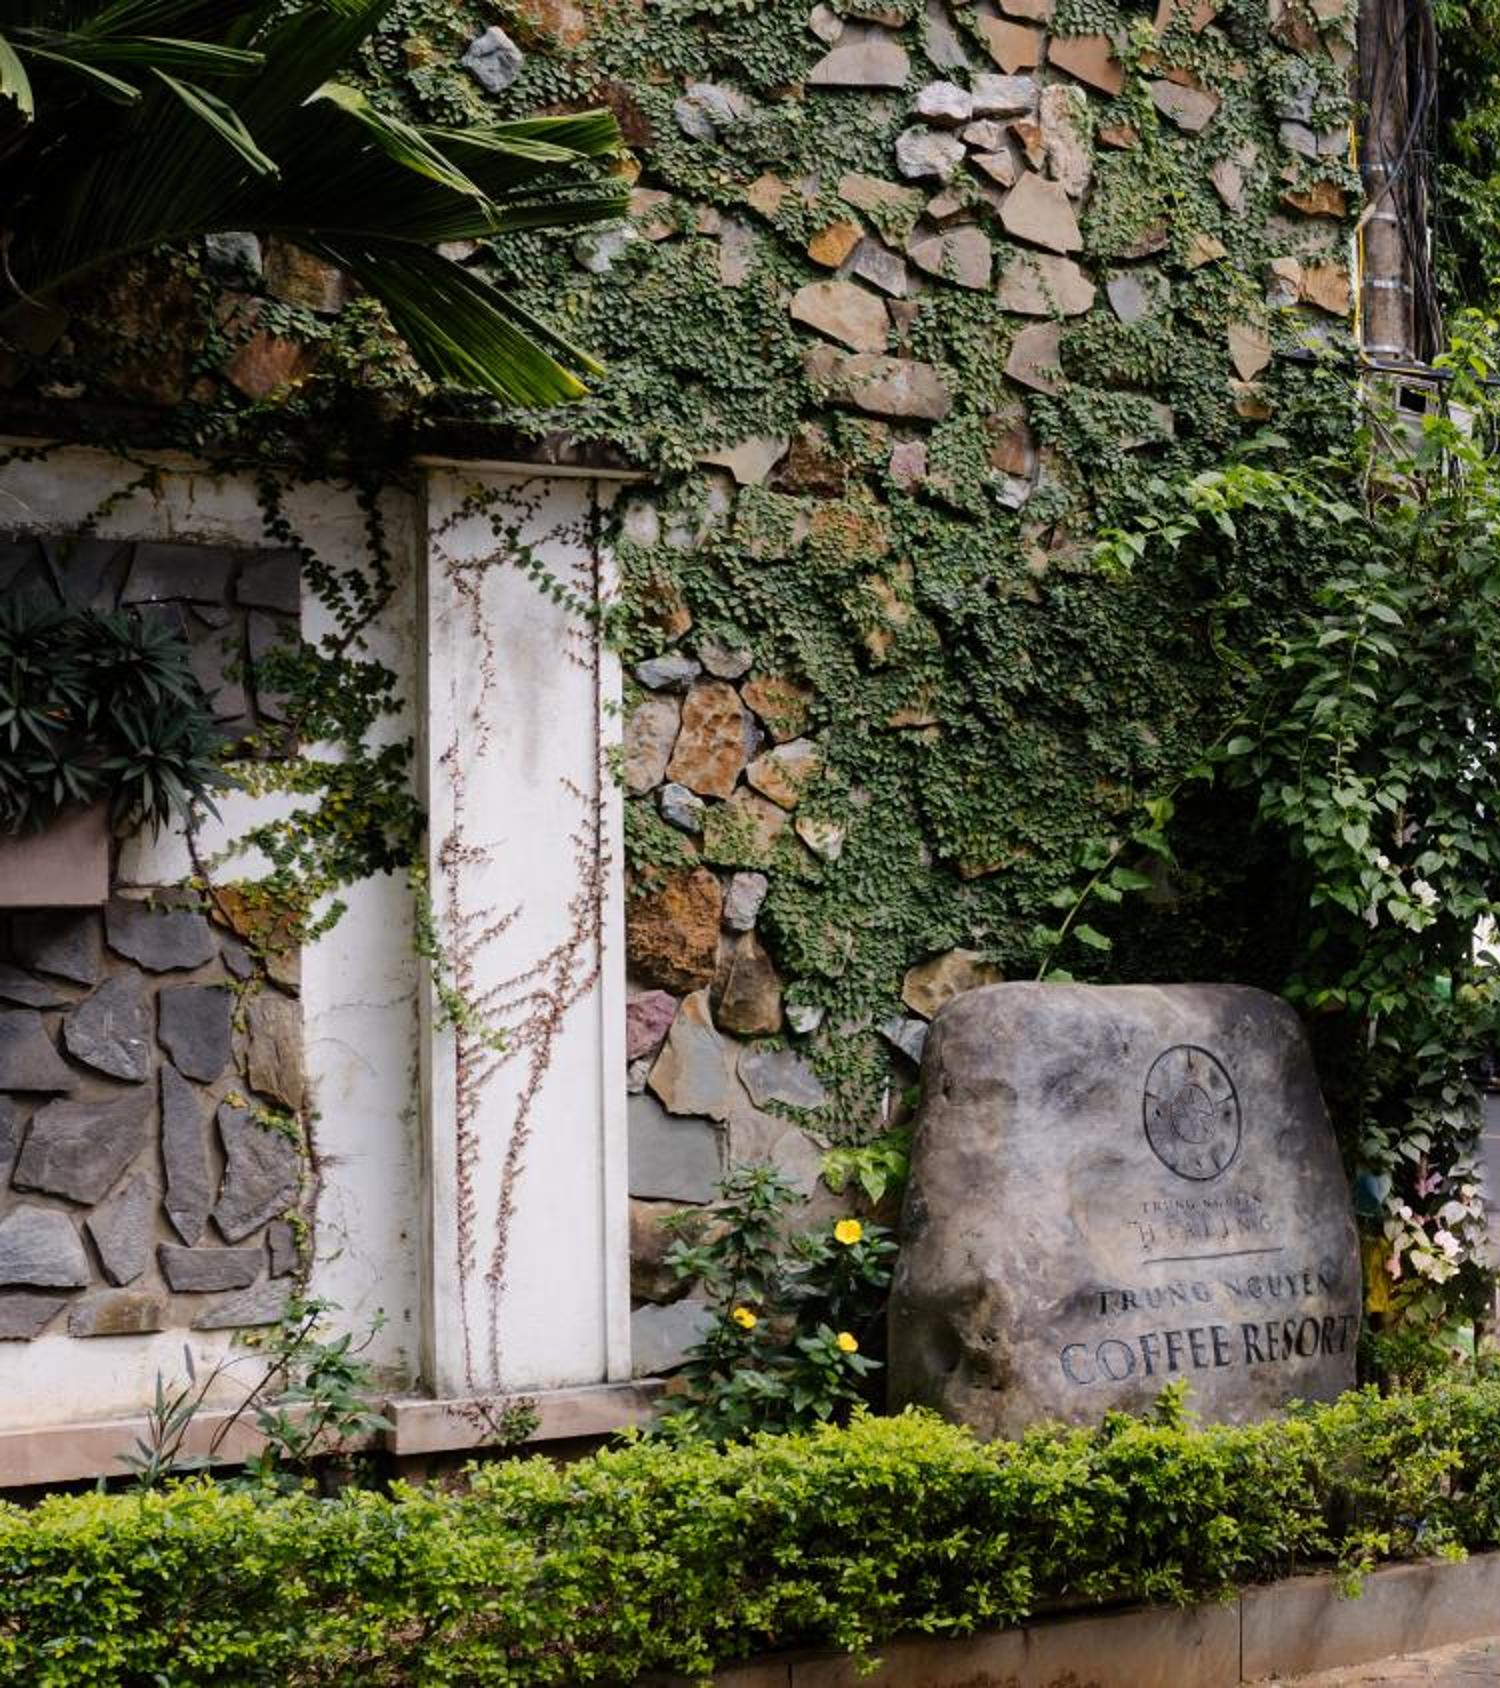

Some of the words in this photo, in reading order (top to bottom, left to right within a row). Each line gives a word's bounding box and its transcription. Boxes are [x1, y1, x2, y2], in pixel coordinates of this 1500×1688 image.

[1097, 1280, 1210, 1314] TRUNG
[1060, 1325, 1231, 1385] COFFEE
[1240, 1314, 1356, 1364] RESORT
